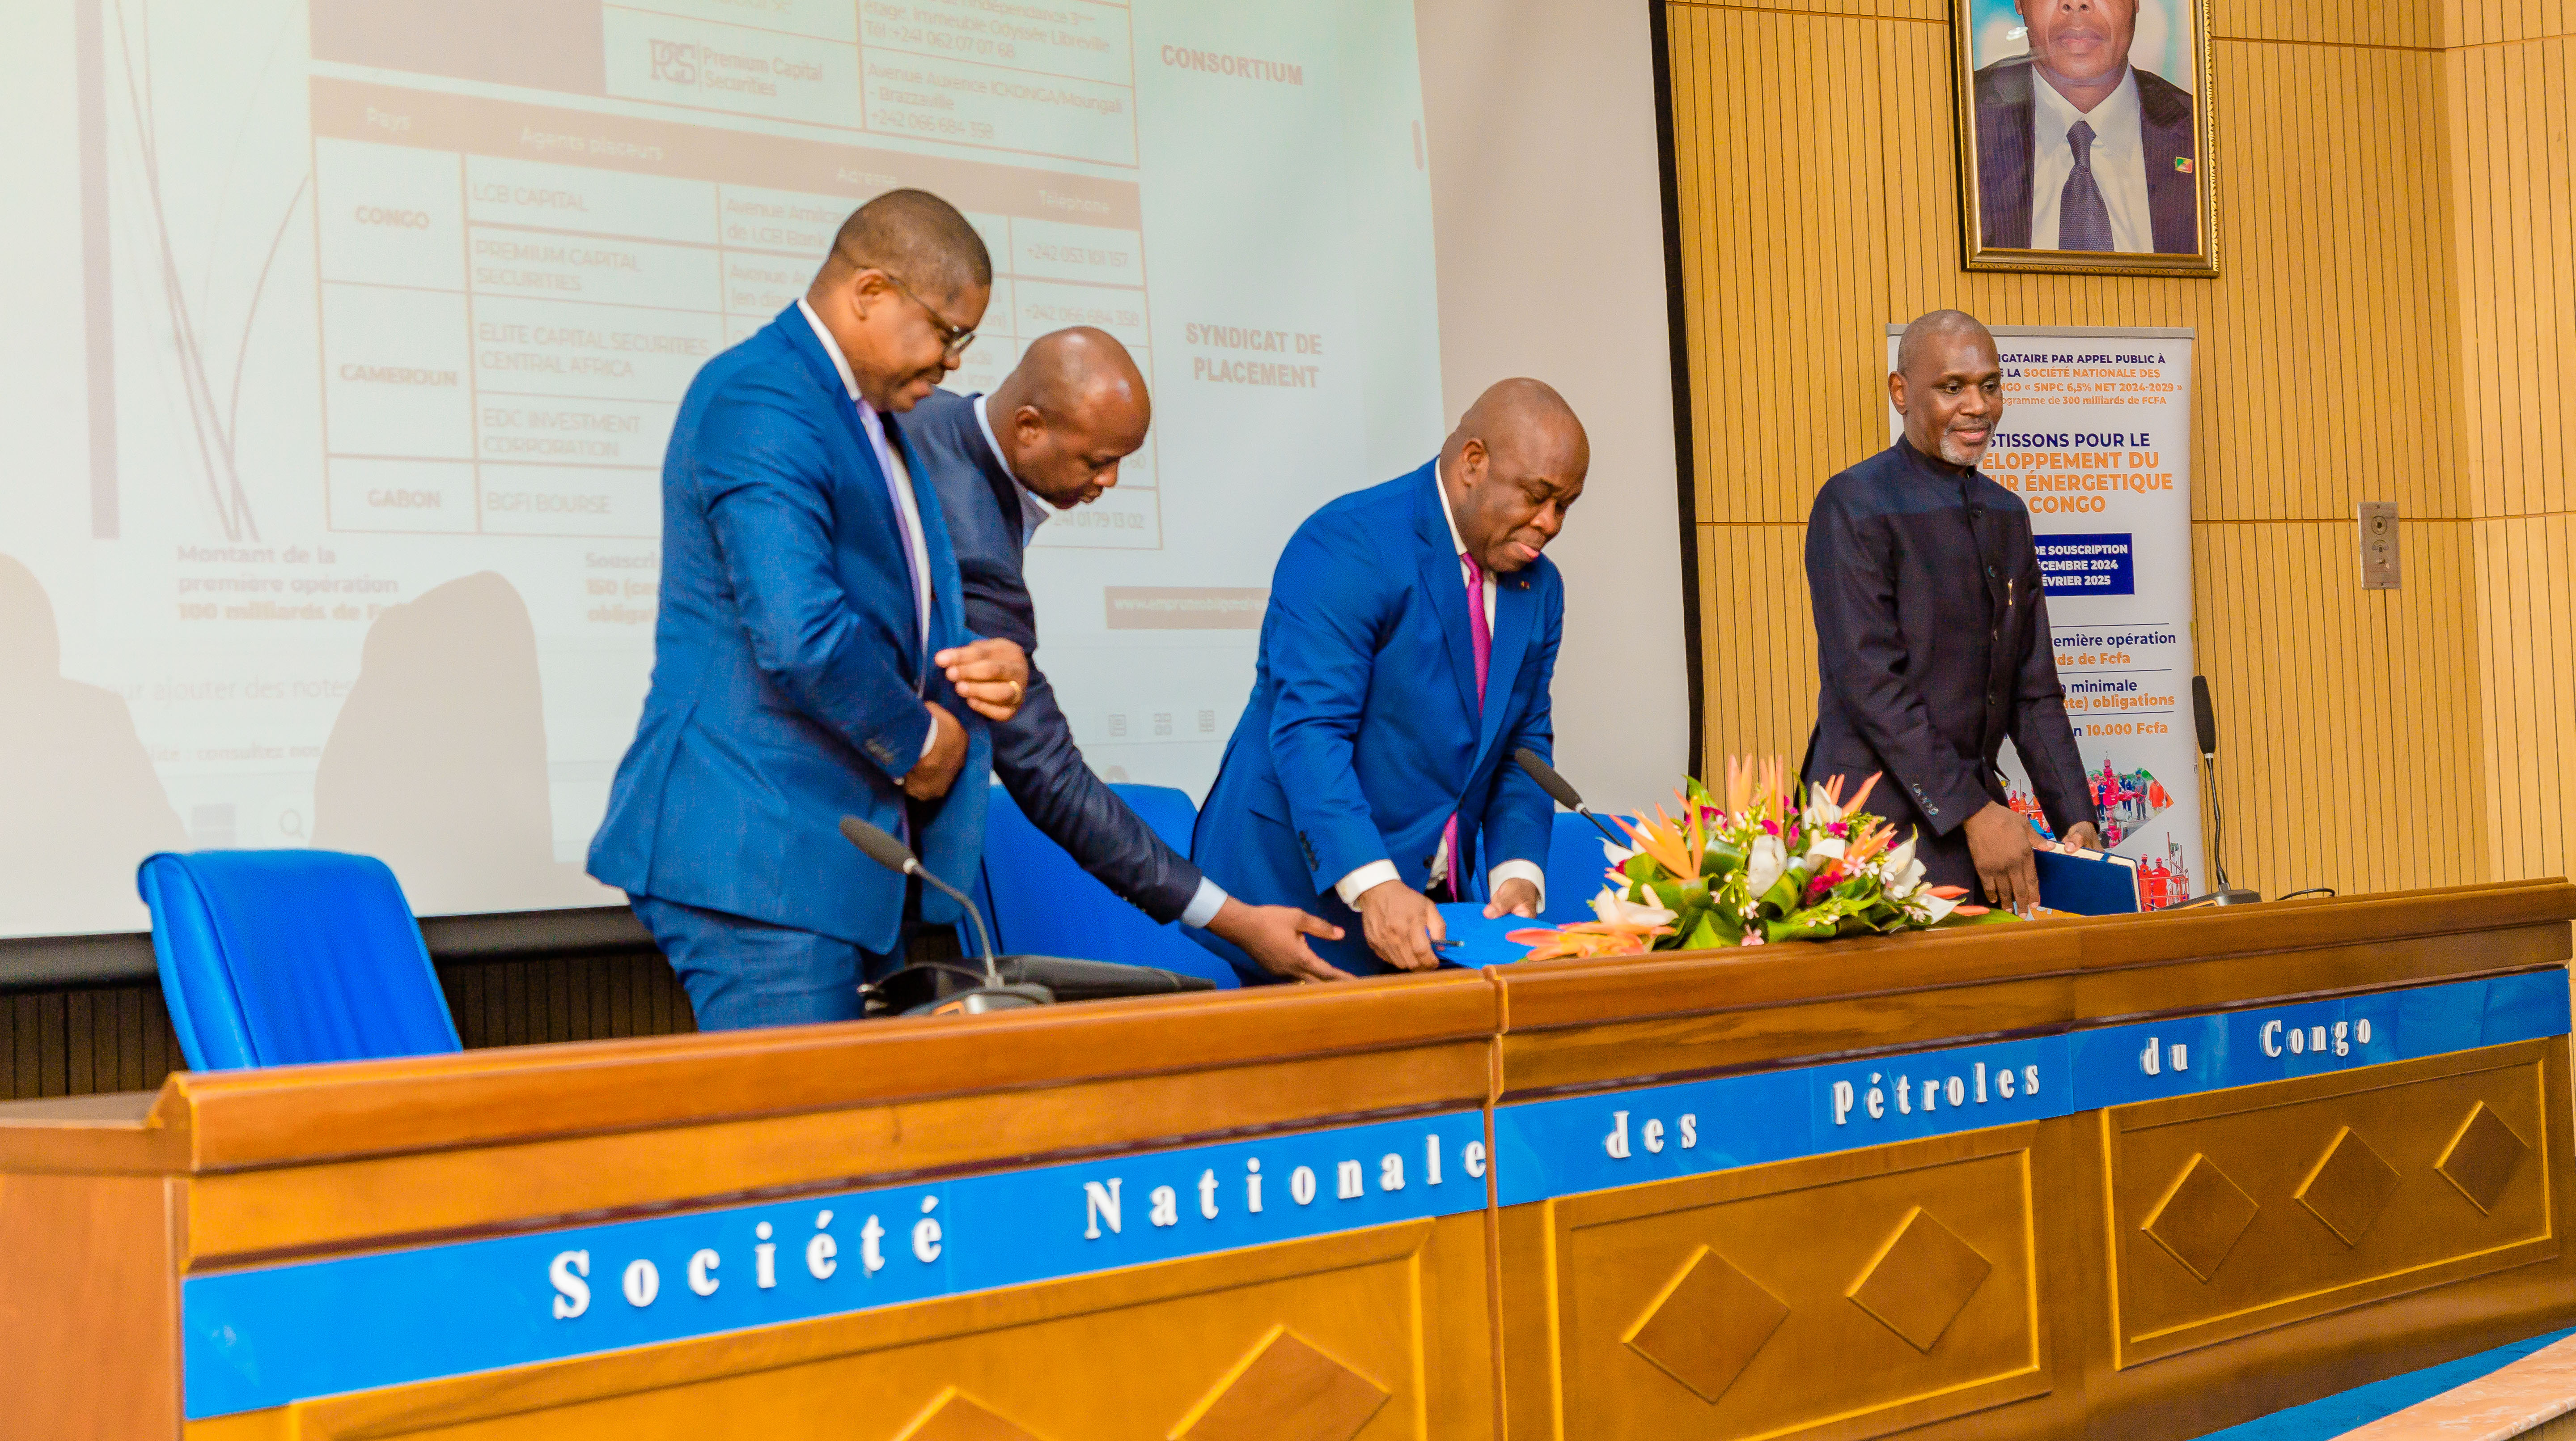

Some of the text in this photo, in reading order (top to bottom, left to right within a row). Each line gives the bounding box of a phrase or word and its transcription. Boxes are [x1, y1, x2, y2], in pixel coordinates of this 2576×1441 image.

[703, 46, 822, 81] Premium Capital
[867, 63, 923, 84] Avenue
[1161, 44, 1303, 86] CONSORTIUM
[704, 70, 778, 97] Securities
[878, 86, 955, 111] Brazzaville
[366, 106, 411, 132] Pays
[521, 126, 664, 161] Agents placeurs
[473, 183, 589, 212] LCB CAPITAL
[727, 198, 784, 218] Avenue
[356, 205, 429, 230] CONGO
[727, 224, 747, 241] de
[753, 226, 783, 244] LCB
[476, 240, 642, 272] PREMIUM CAPITAL
[476, 267, 581, 291] SECURITIES
[479, 323, 709, 356] ELITE CAPITAL SECURITIES
[1186, 322, 1322, 355] SYNDICAT DE
[481, 351, 634, 378] CENTRAL AFRICA
[2051, 354, 2073, 363] PAR
[2076, 354, 2112, 363] APPEL
[2116, 354, 2154, 364] PUBLIC
[2158, 352, 2166, 363] À
[340, 364, 457, 386] CAMEROUN
[1194, 357, 1319, 389] PLACEMENT
[2007, 368, 2021, 377] LA
[2024, 366, 2070, 378] SOCIÉTÉ
[2073, 368, 2136, 378] NATIONALE
[2140, 369, 2161, 378] DES
[2034, 383, 2063, 392] SNPC
[2067, 383, 2092, 394] 6,5%
[2094, 383, 2116, 392] NET
[2119, 383, 2174, 392] 2024-2029
[2048, 396, 2060, 404] de
[2063, 396, 2080, 404] 300
[2083, 395, 2124, 404] milliards
[2127, 396, 2140, 404] de
[2142, 396, 2167, 404] FCFA
[483, 408, 640, 433] EDC INVESTMENT
[484, 436, 619, 457] CORPORATION
[2075, 433, 2124, 447] POUR
[2131, 433, 2150, 447] LE
[1983, 452, 2159, 469] ELOPPEMENT DU
[2025, 470, 2173, 493] ÉNERGETIQUE
[368, 489, 441, 509] GABON
[488, 493, 610, 514] BGFI BOURSE
[2029, 495, 2106, 513] CONGO
[178, 546, 336, 564] Montant de la
[2048, 544, 2128, 555] SOUSCRIPTION
[2037, 559, 2118, 570] CEMBRE 2024
[178, 571, 398, 594] première opération
[2042, 574, 2111, 586] ÉVRIER 2025
[178, 604, 217, 620] 100
[226, 601, 326, 620] milliards
[333, 603, 360, 620] de
[2107, 631, 2176, 648] opération
[2078, 653, 2096, 665] de
[2100, 652, 2131, 665] Fcfa
[153, 676, 237, 709] ajouter
[245, 675, 284, 699] des
[2072, 679, 2137, 693] minimale
[2093, 693, 2175, 710] obligations
[2086, 723, 2132, 736] 10.000
[2137, 722, 2168, 735] Fcfa
[549, 1194, 943, 1319] Société
[1083, 1133, 1486, 1240] Nationale
[1606, 1110, 1697, 1159] des
[2140, 1037, 2188, 1075] du
[2260, 1018, 2371, 1057] Congo
